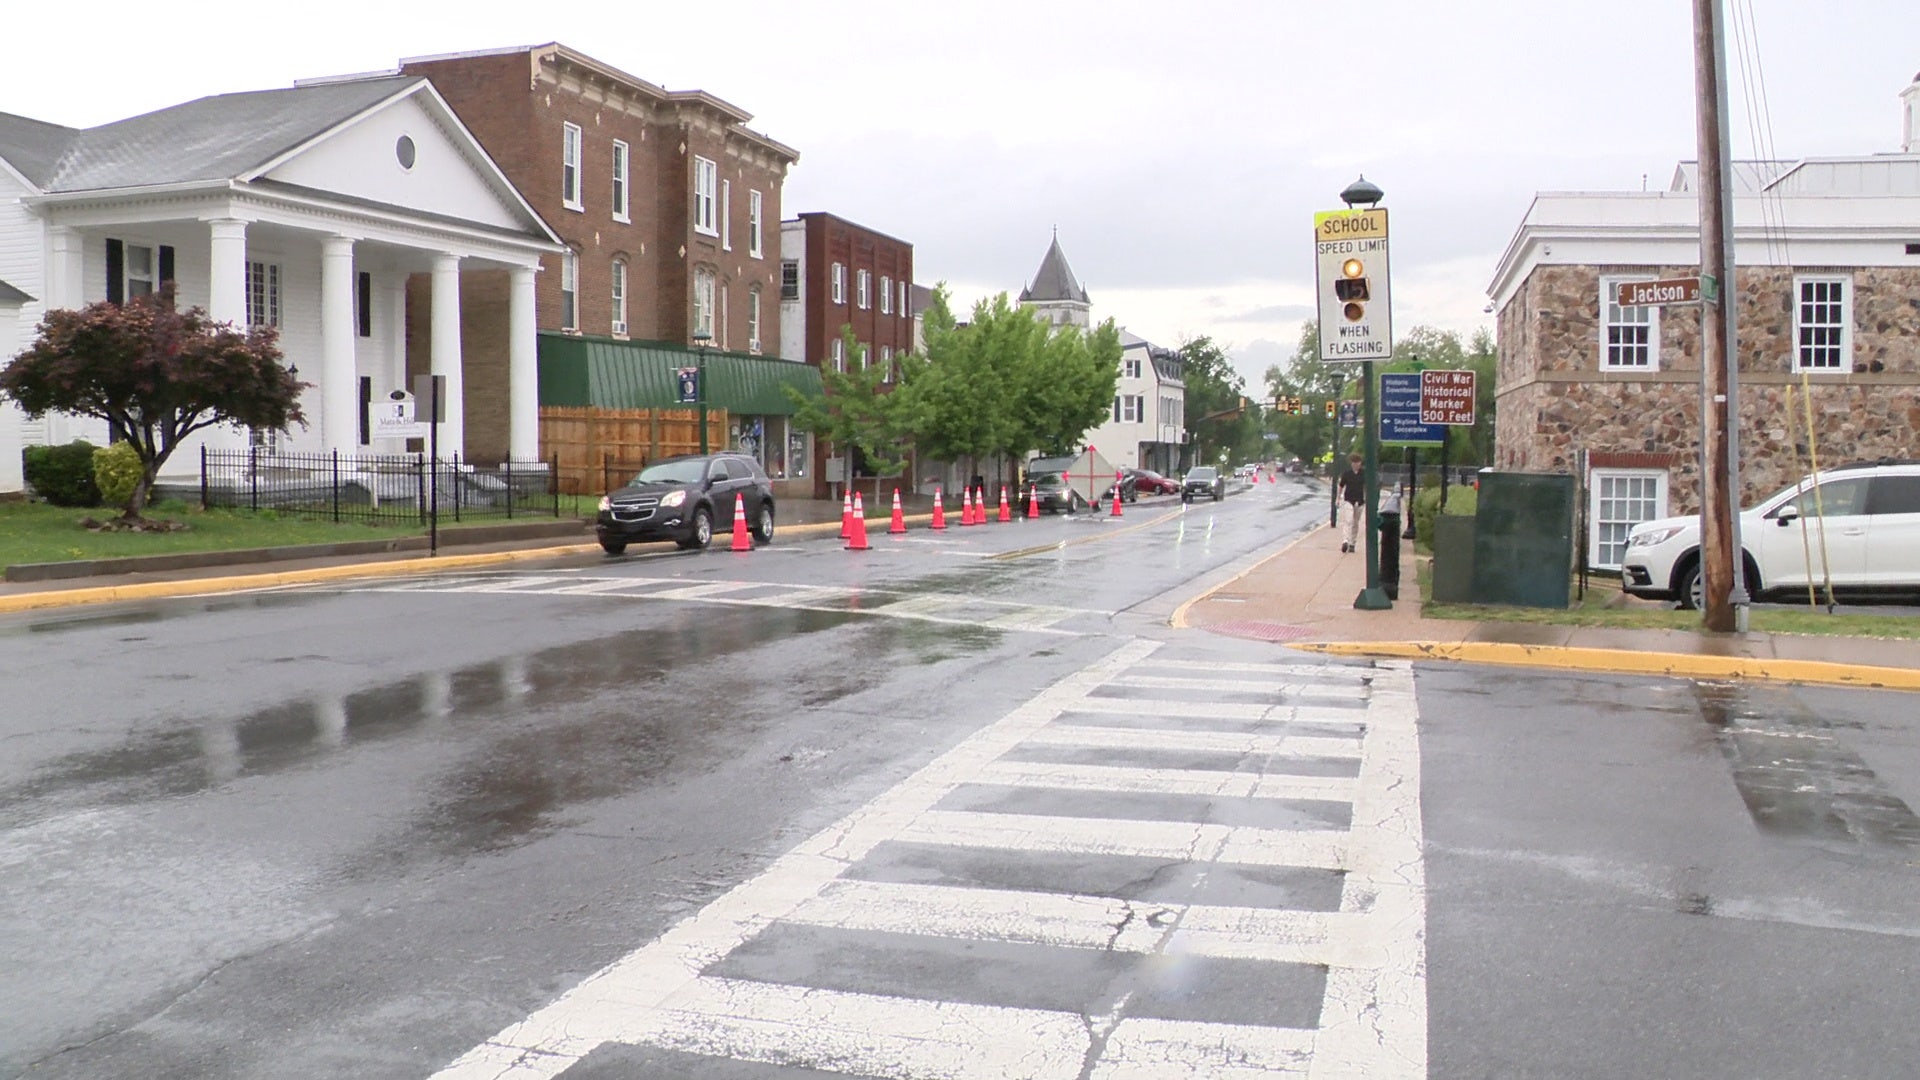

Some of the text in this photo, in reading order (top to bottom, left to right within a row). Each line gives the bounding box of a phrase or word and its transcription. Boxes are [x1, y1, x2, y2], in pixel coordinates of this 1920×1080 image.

[1324, 218, 1378, 234] SCHOOL
[1319, 240, 1386, 254] SPEED LIMIT
[1629, 284, 1684, 303] Jackson
[1339, 325, 1369, 337] WHEN
[1330, 341, 1383, 354] FLASHING
[1425, 373, 1471, 384] Civil War
[1424, 386, 1471, 397] Historical
[1430, 398, 1464, 409] Marker
[1423, 410, 1471, 422] 500 Feet
